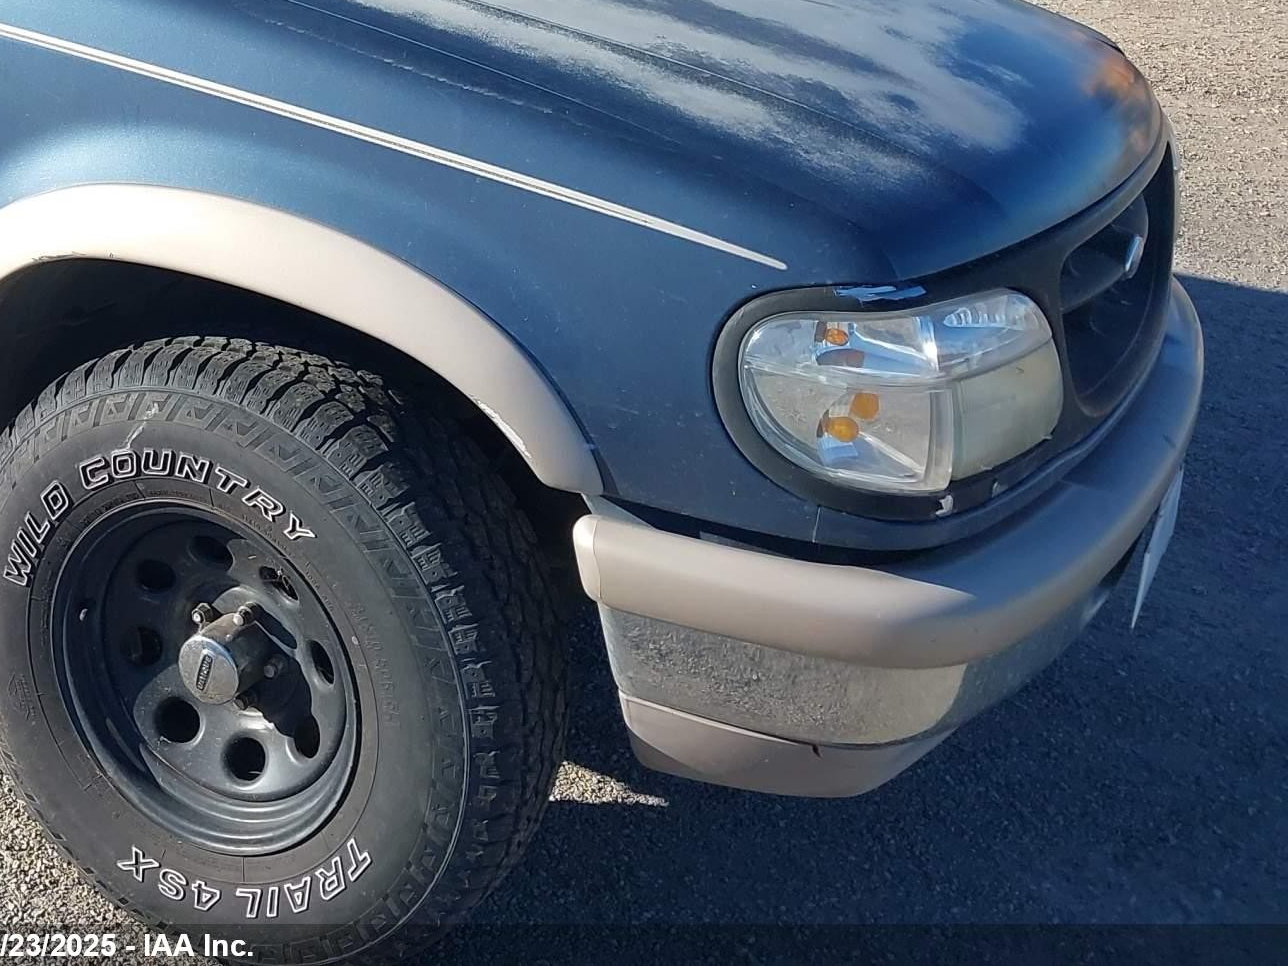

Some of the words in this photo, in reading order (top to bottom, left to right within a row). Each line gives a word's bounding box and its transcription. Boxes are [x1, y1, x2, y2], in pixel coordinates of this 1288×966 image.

[3, 480, 71, 587] WILD
[78, 447, 318, 541] COUNTRY
[116, 844, 222, 912] 4SX
[235, 837, 372, 919] TRAIL
